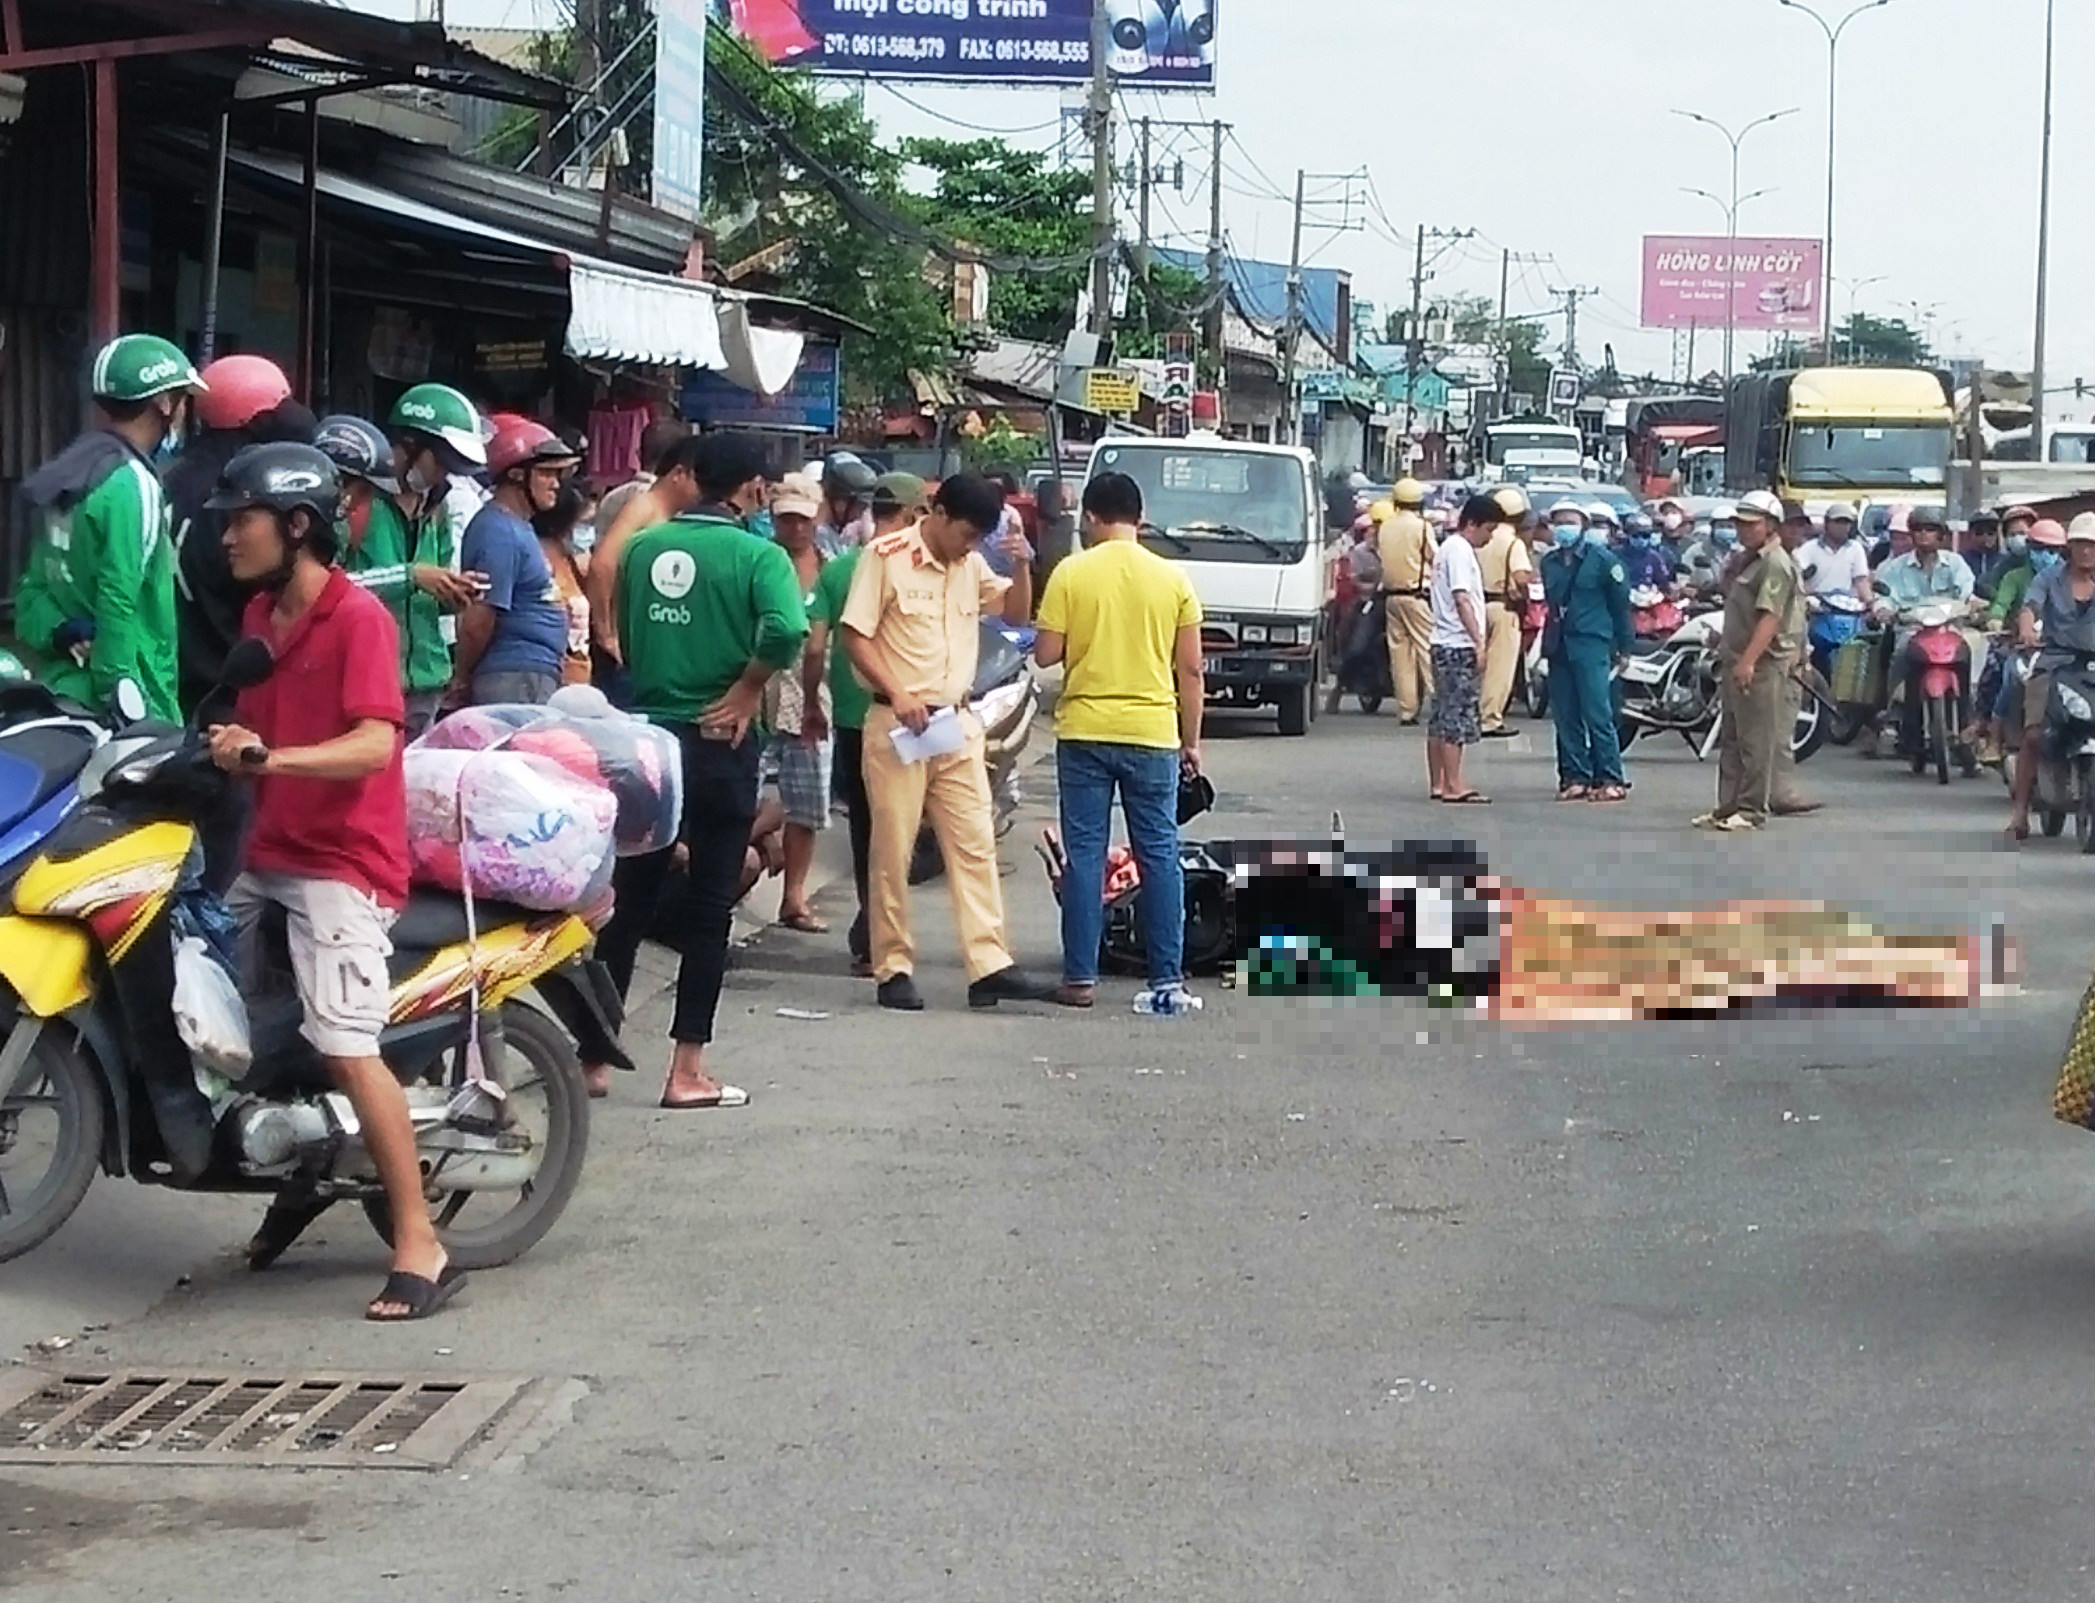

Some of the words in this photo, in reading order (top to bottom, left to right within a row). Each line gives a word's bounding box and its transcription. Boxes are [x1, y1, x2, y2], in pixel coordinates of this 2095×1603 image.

[959, 38, 993, 60] FAX:
[1714, 254, 1761, 273] LINH
[139, 358, 178, 384] Grab
[402, 401, 436, 421] Grab
[648, 602, 691, 625] Grab
